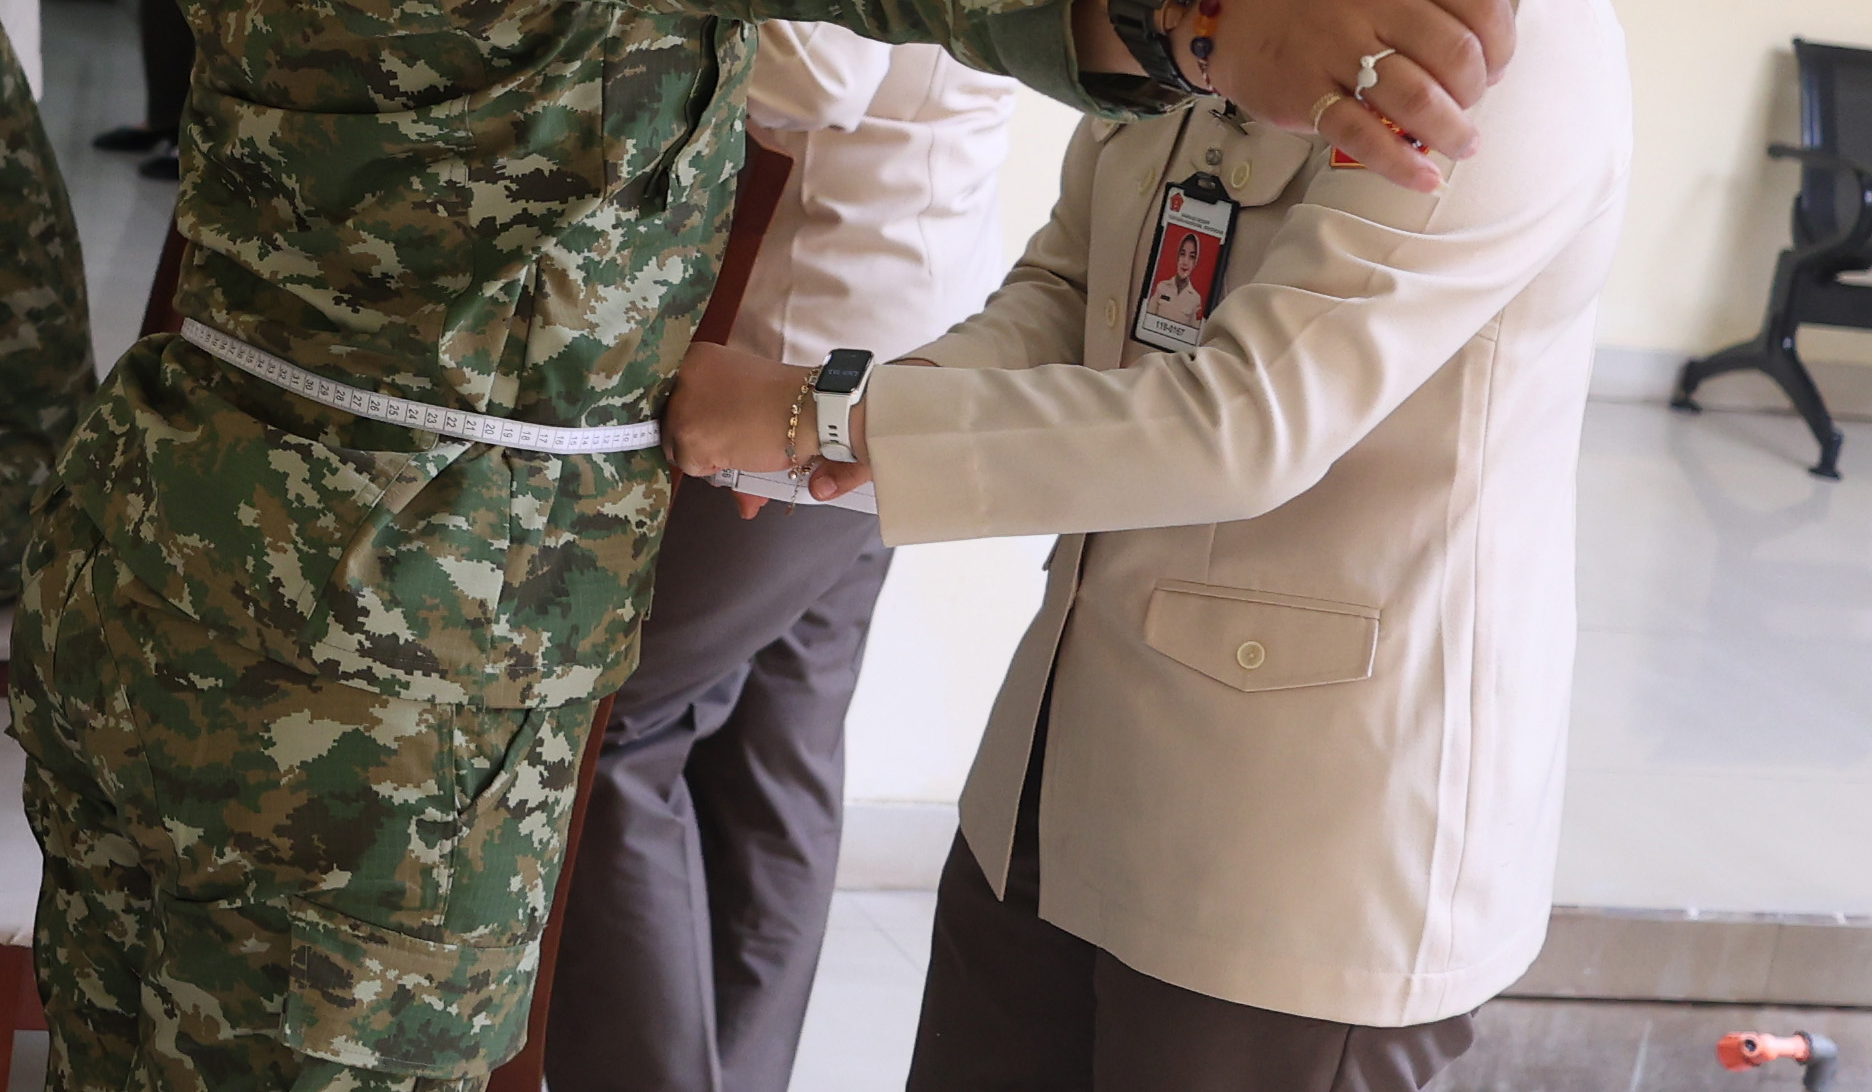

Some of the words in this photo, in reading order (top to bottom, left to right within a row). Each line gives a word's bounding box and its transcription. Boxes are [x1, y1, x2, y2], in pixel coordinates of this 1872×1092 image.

[352, 394, 362, 408] 27
[370, 400, 381, 412] 26
[388, 404, 399, 416] 25
[408, 408, 419, 420] 24
[428, 412, 438, 424] 23
[447, 416, 457, 428] 22
[466, 420, 476, 431] 21
[484, 424, 496, 435] 20
[502, 428, 514, 438] 19
[521, 431, 531, 441] 18
[539, 434, 548, 444] 17
